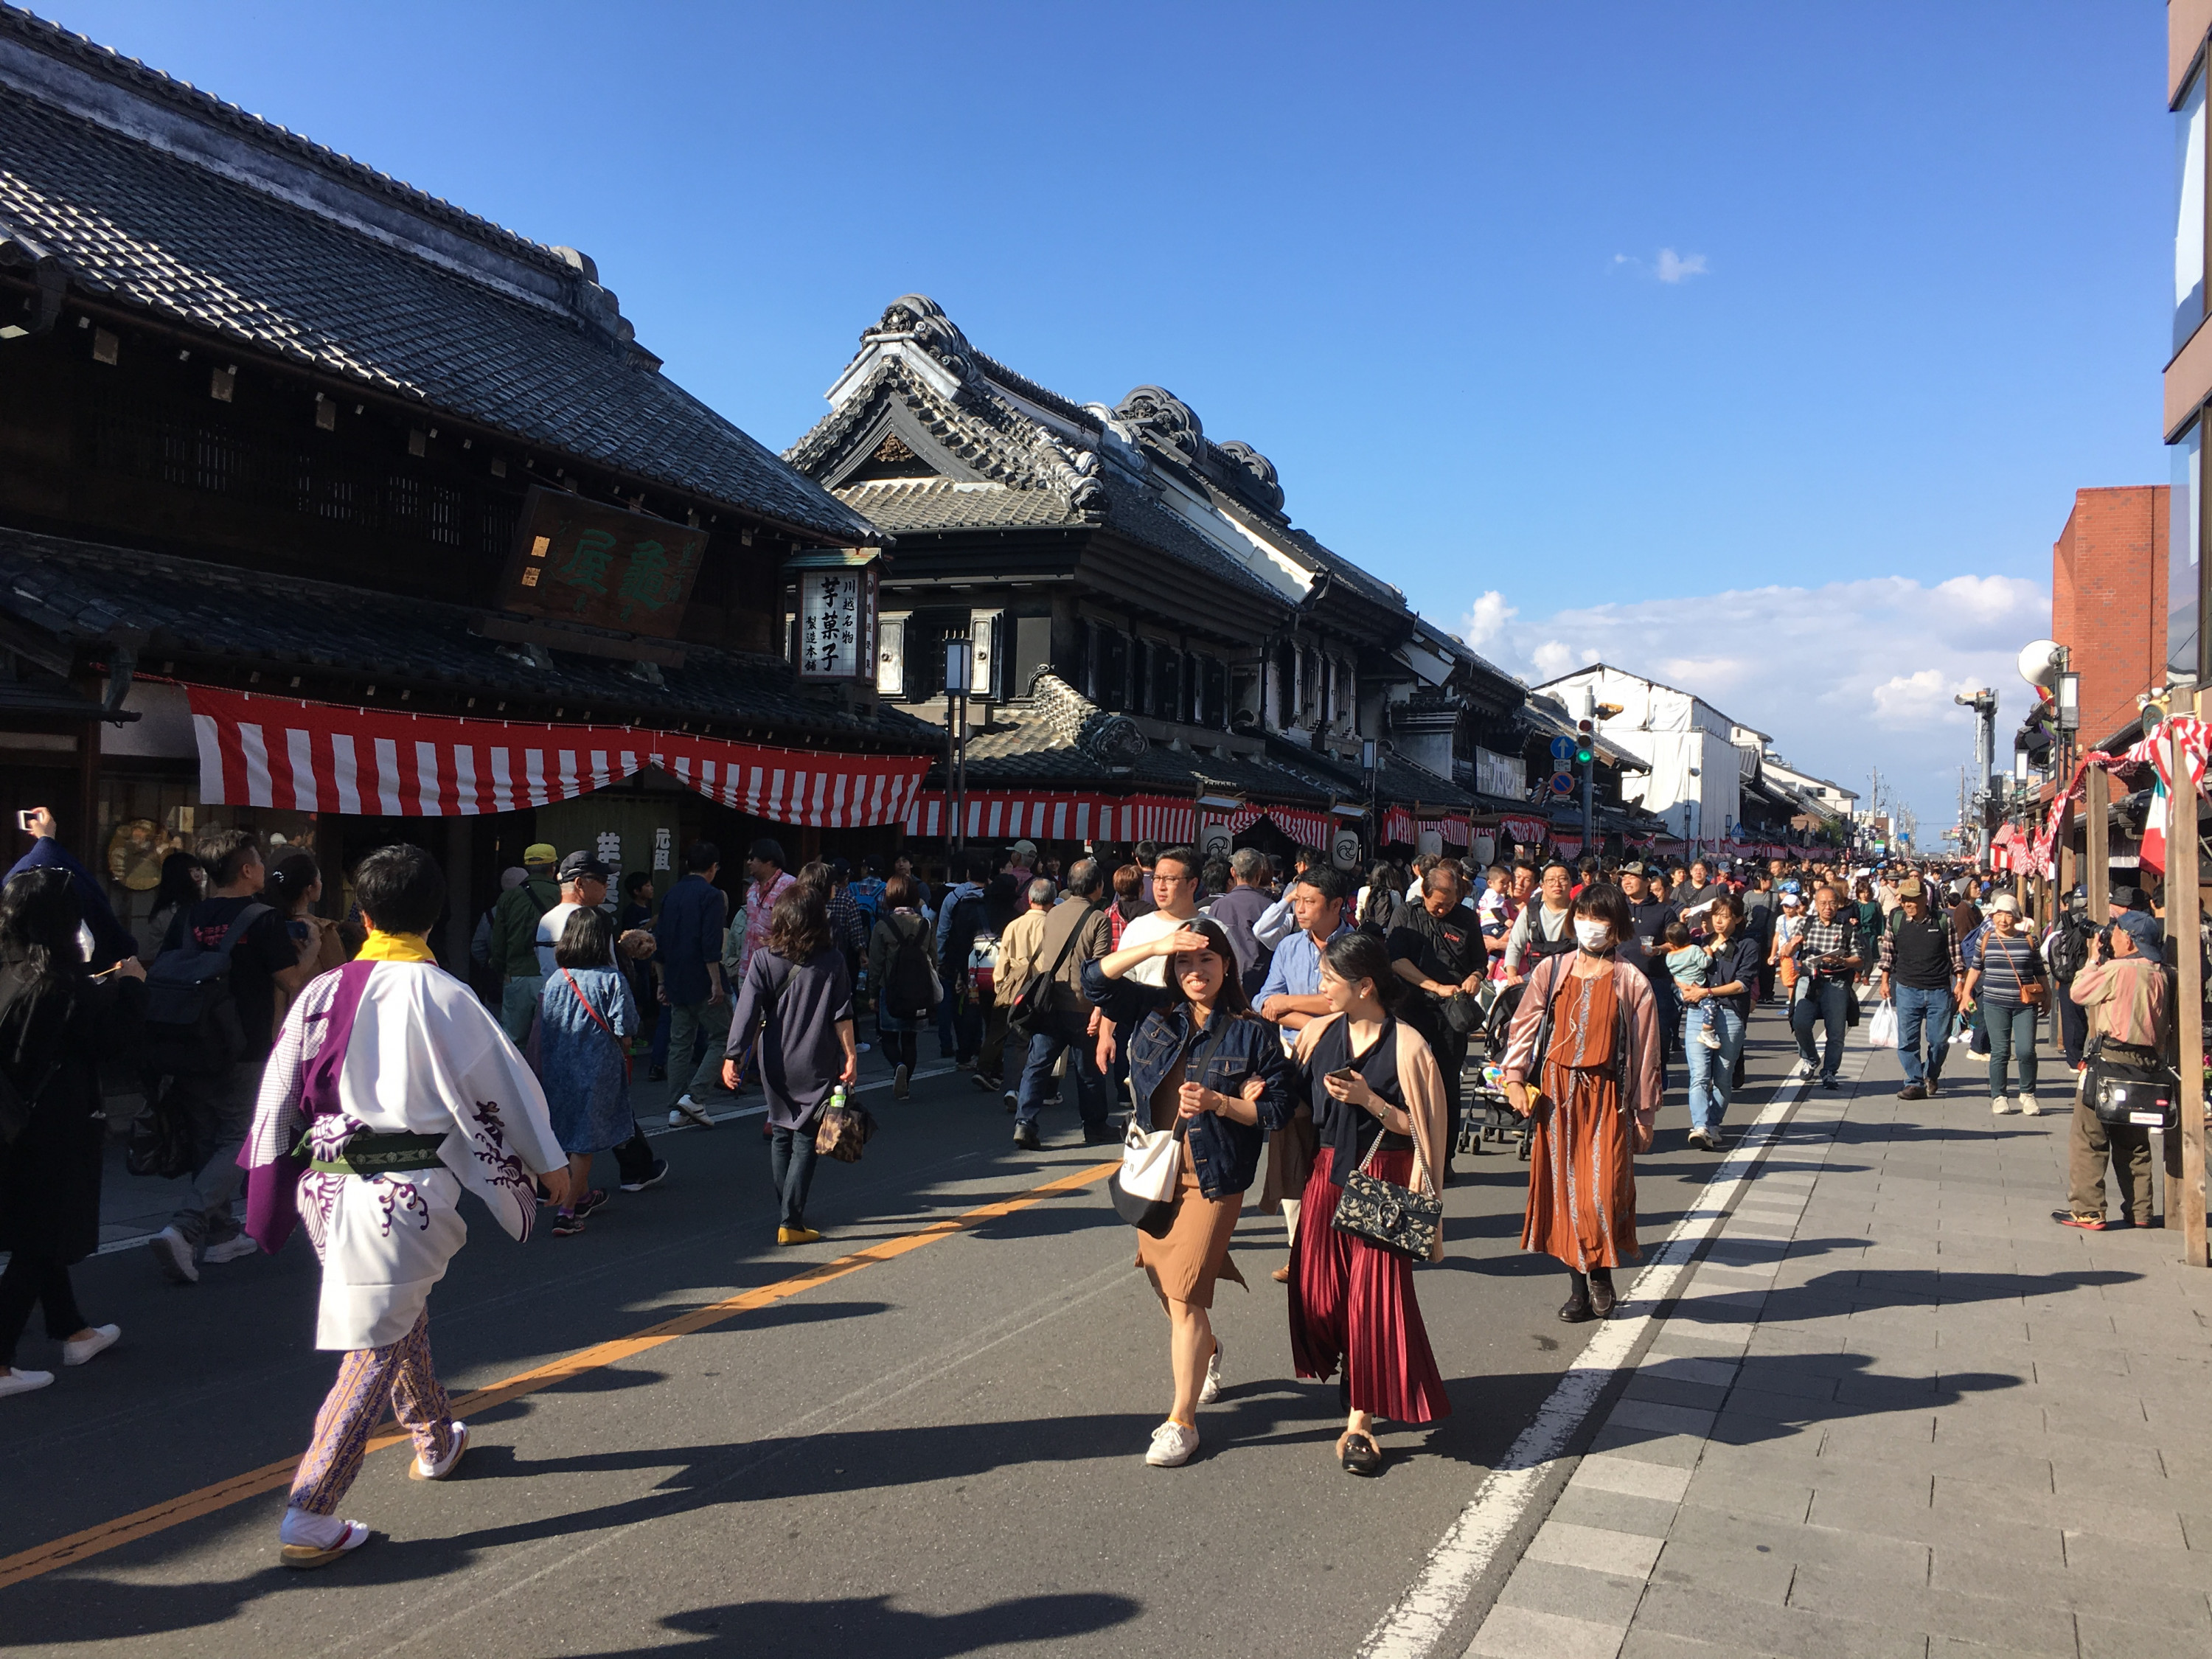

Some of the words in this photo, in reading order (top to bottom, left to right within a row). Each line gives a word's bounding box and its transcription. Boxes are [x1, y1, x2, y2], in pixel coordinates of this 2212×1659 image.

[821, 577, 840, 672] 芋菓子
[842, 580, 855, 644] 川越名物
[654, 828, 671, 871] 元祖
